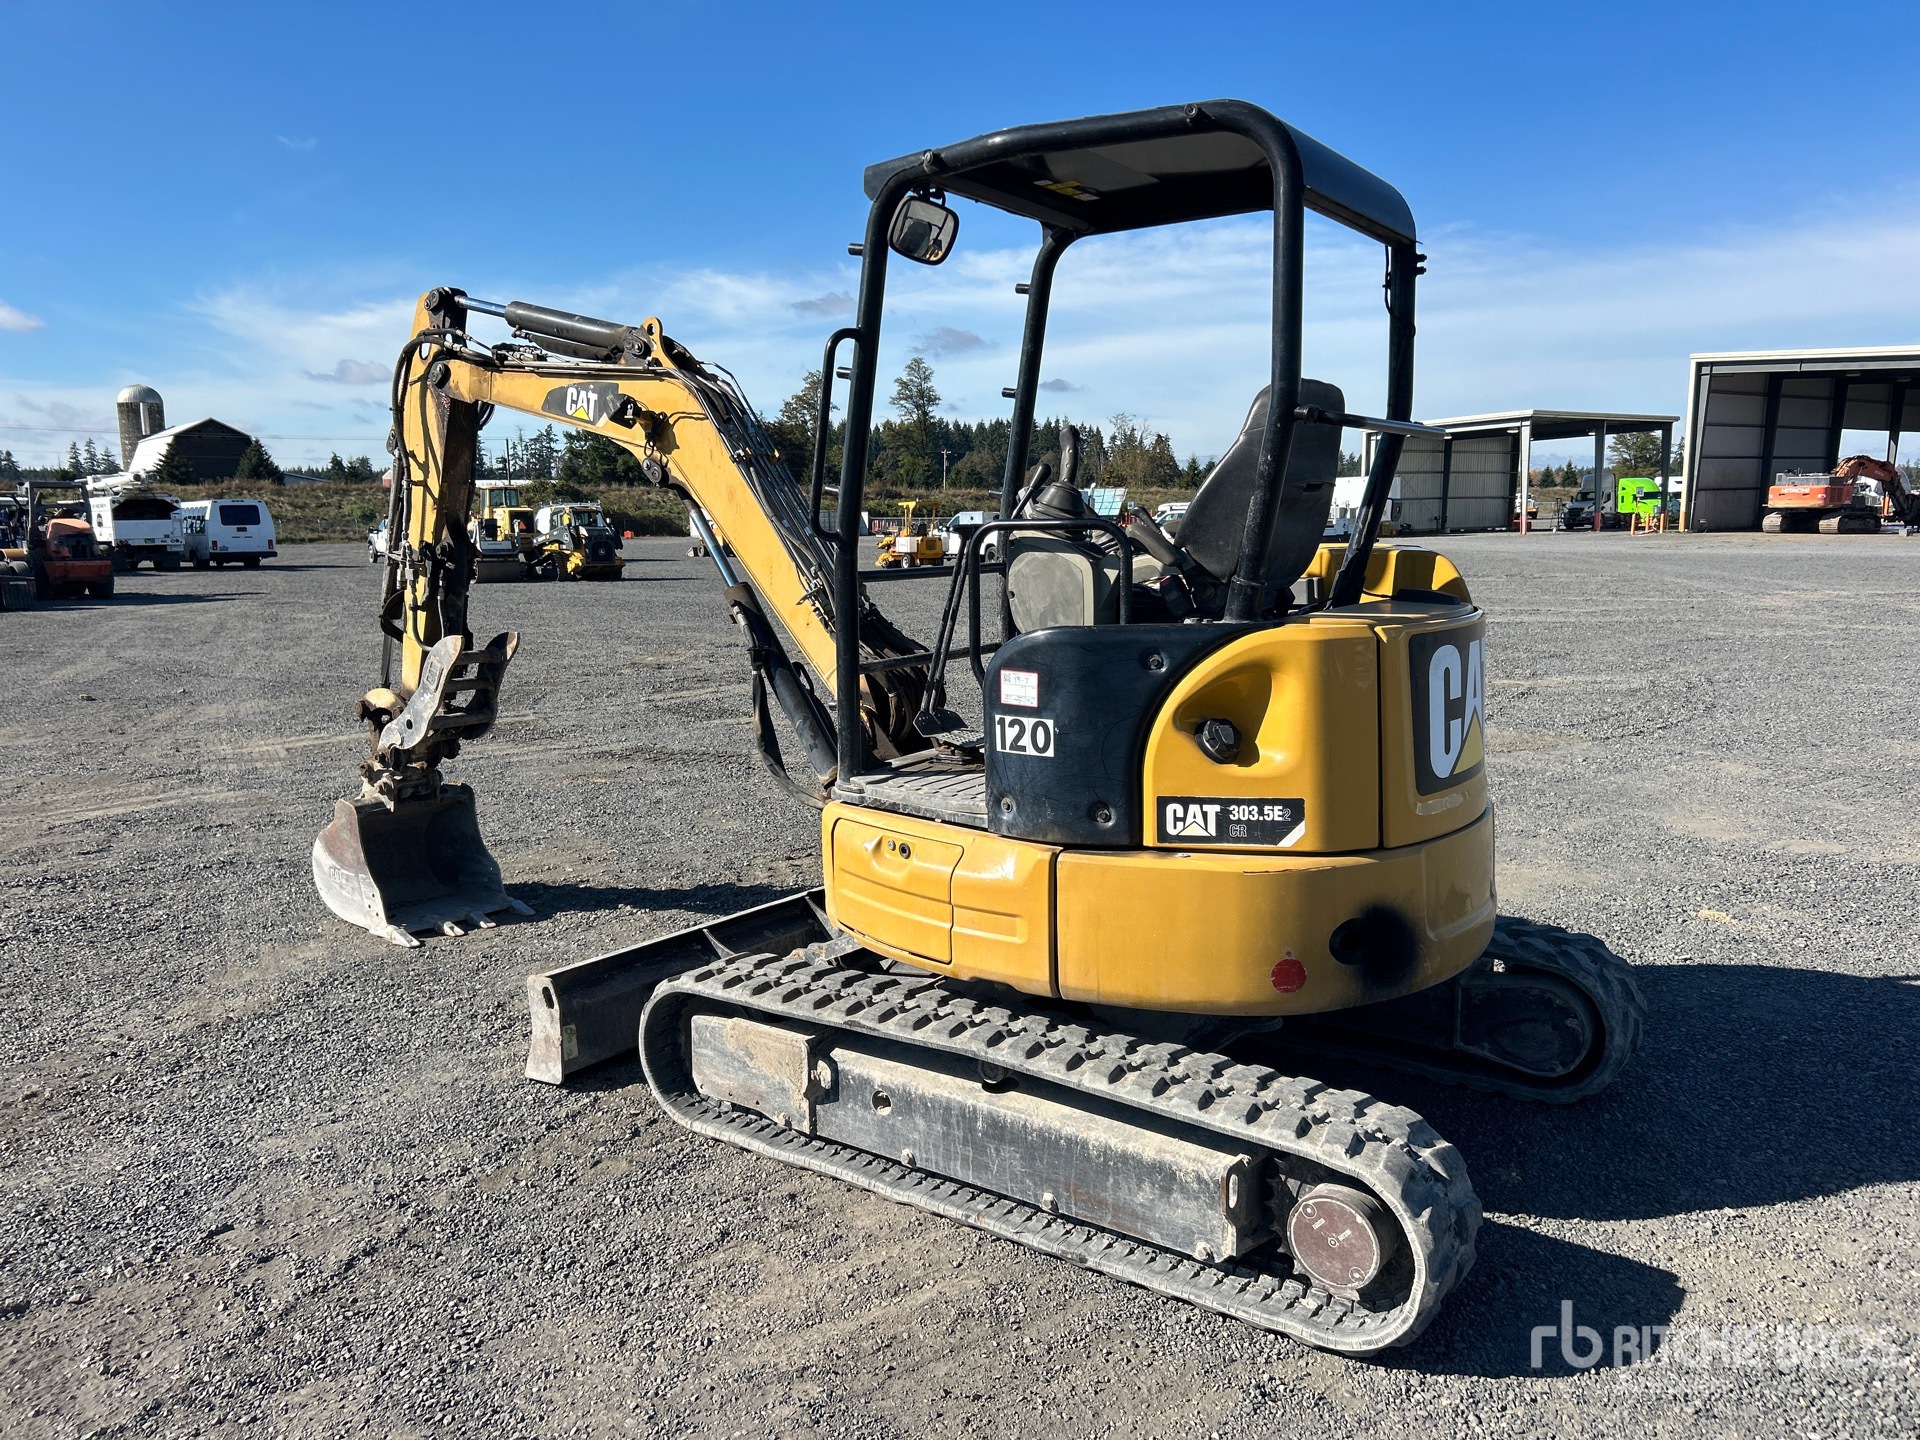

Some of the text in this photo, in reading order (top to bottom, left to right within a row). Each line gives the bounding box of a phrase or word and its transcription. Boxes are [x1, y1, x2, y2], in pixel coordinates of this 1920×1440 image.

[565, 386, 598, 422] CAT
[1428, 636, 1486, 779] CA
[996, 716, 1052, 755] 120
[1165, 803, 1292, 837] CAT 303.5E2
[1228, 823, 1248, 838] CR
